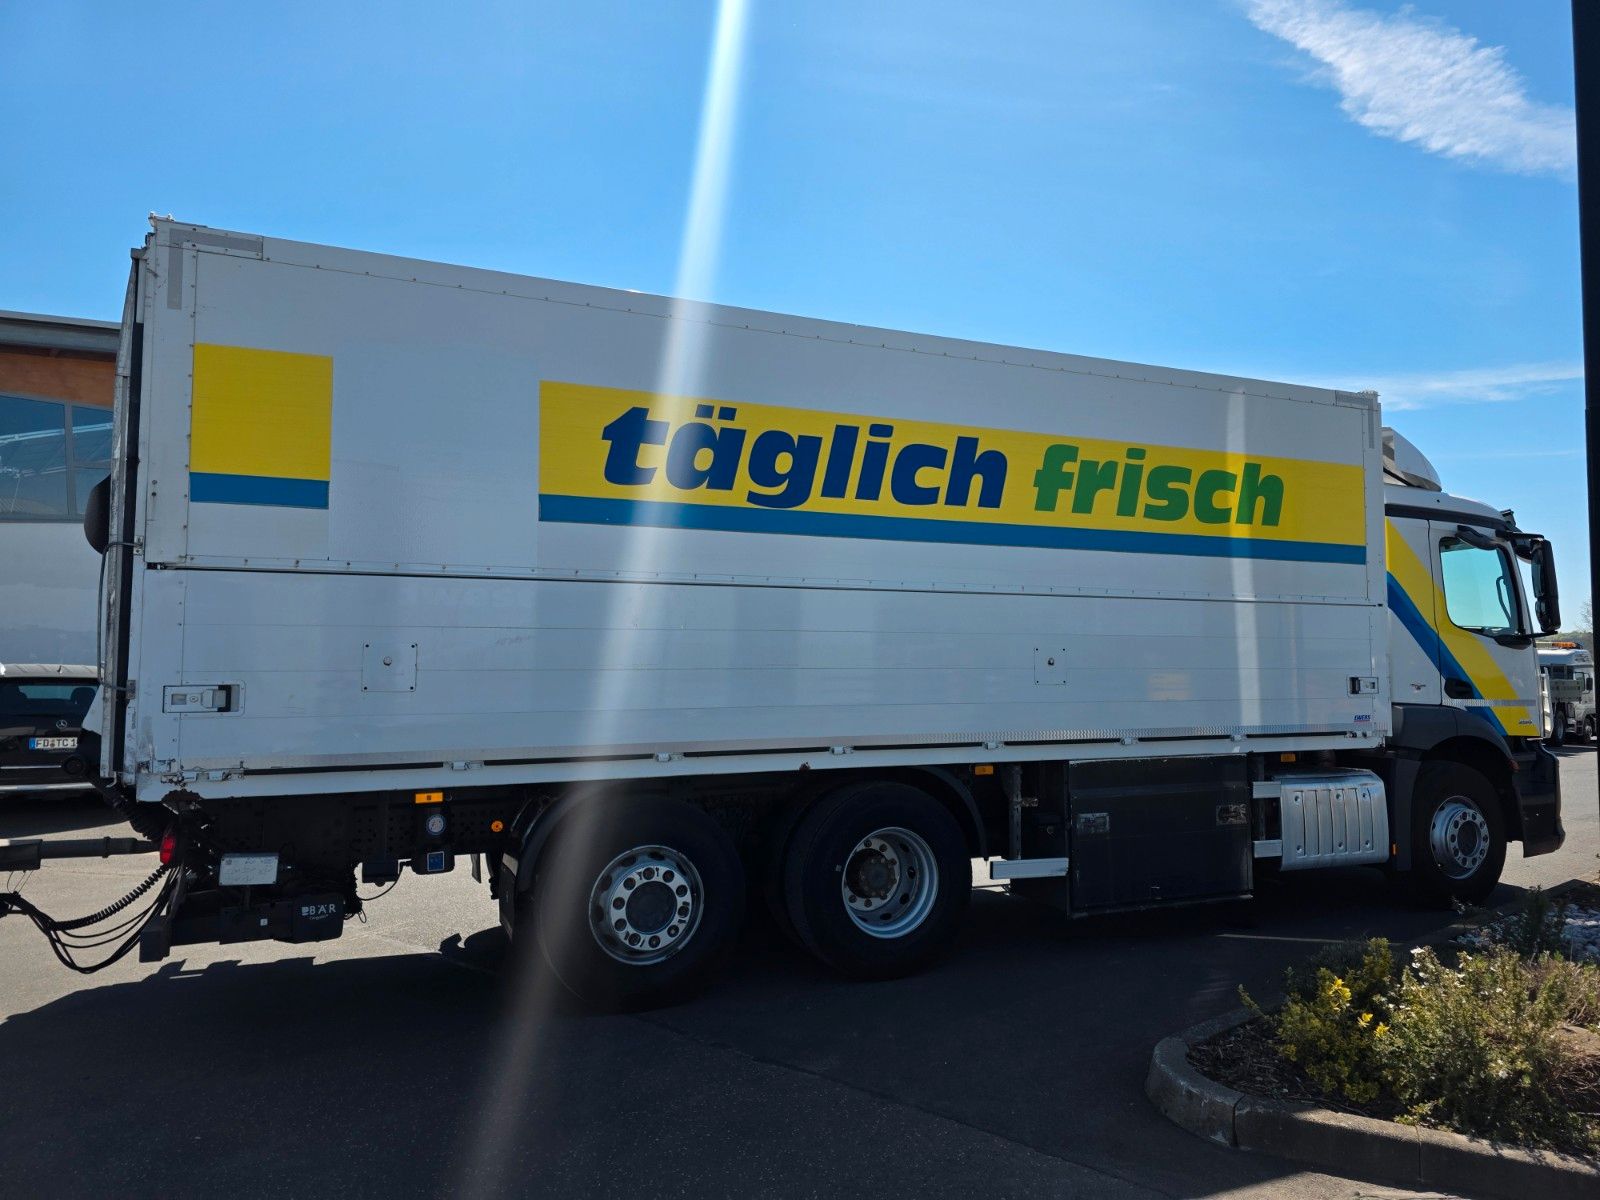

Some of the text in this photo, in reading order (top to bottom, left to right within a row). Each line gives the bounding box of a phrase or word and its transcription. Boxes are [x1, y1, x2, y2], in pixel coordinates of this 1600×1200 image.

[602, 404, 1285, 527] täglich frisch
[309, 903, 336, 915] BÄR
